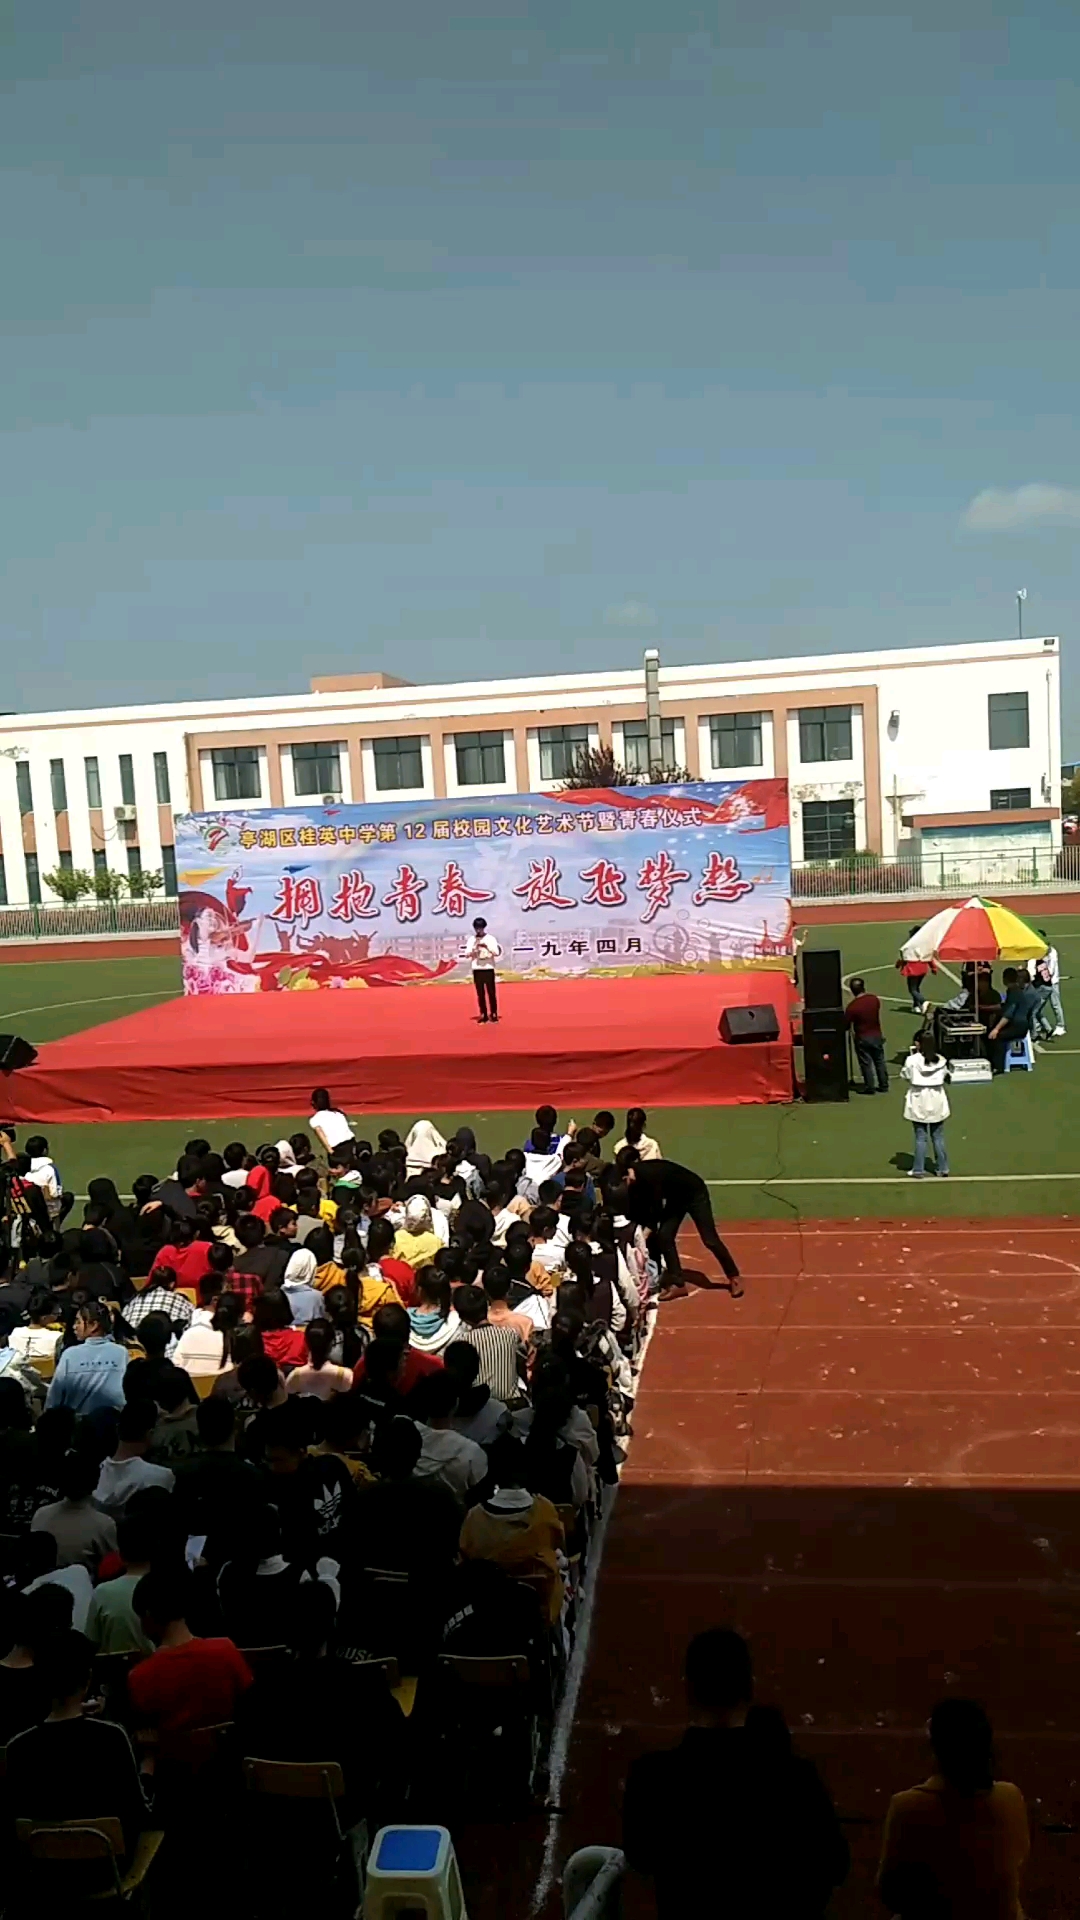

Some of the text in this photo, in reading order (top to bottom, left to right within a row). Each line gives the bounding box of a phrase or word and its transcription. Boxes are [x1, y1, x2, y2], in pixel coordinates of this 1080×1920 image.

[270, 850, 754, 928] 拥抱青春 放飞梦想
[459, 937, 642, 957] 一九年四月
